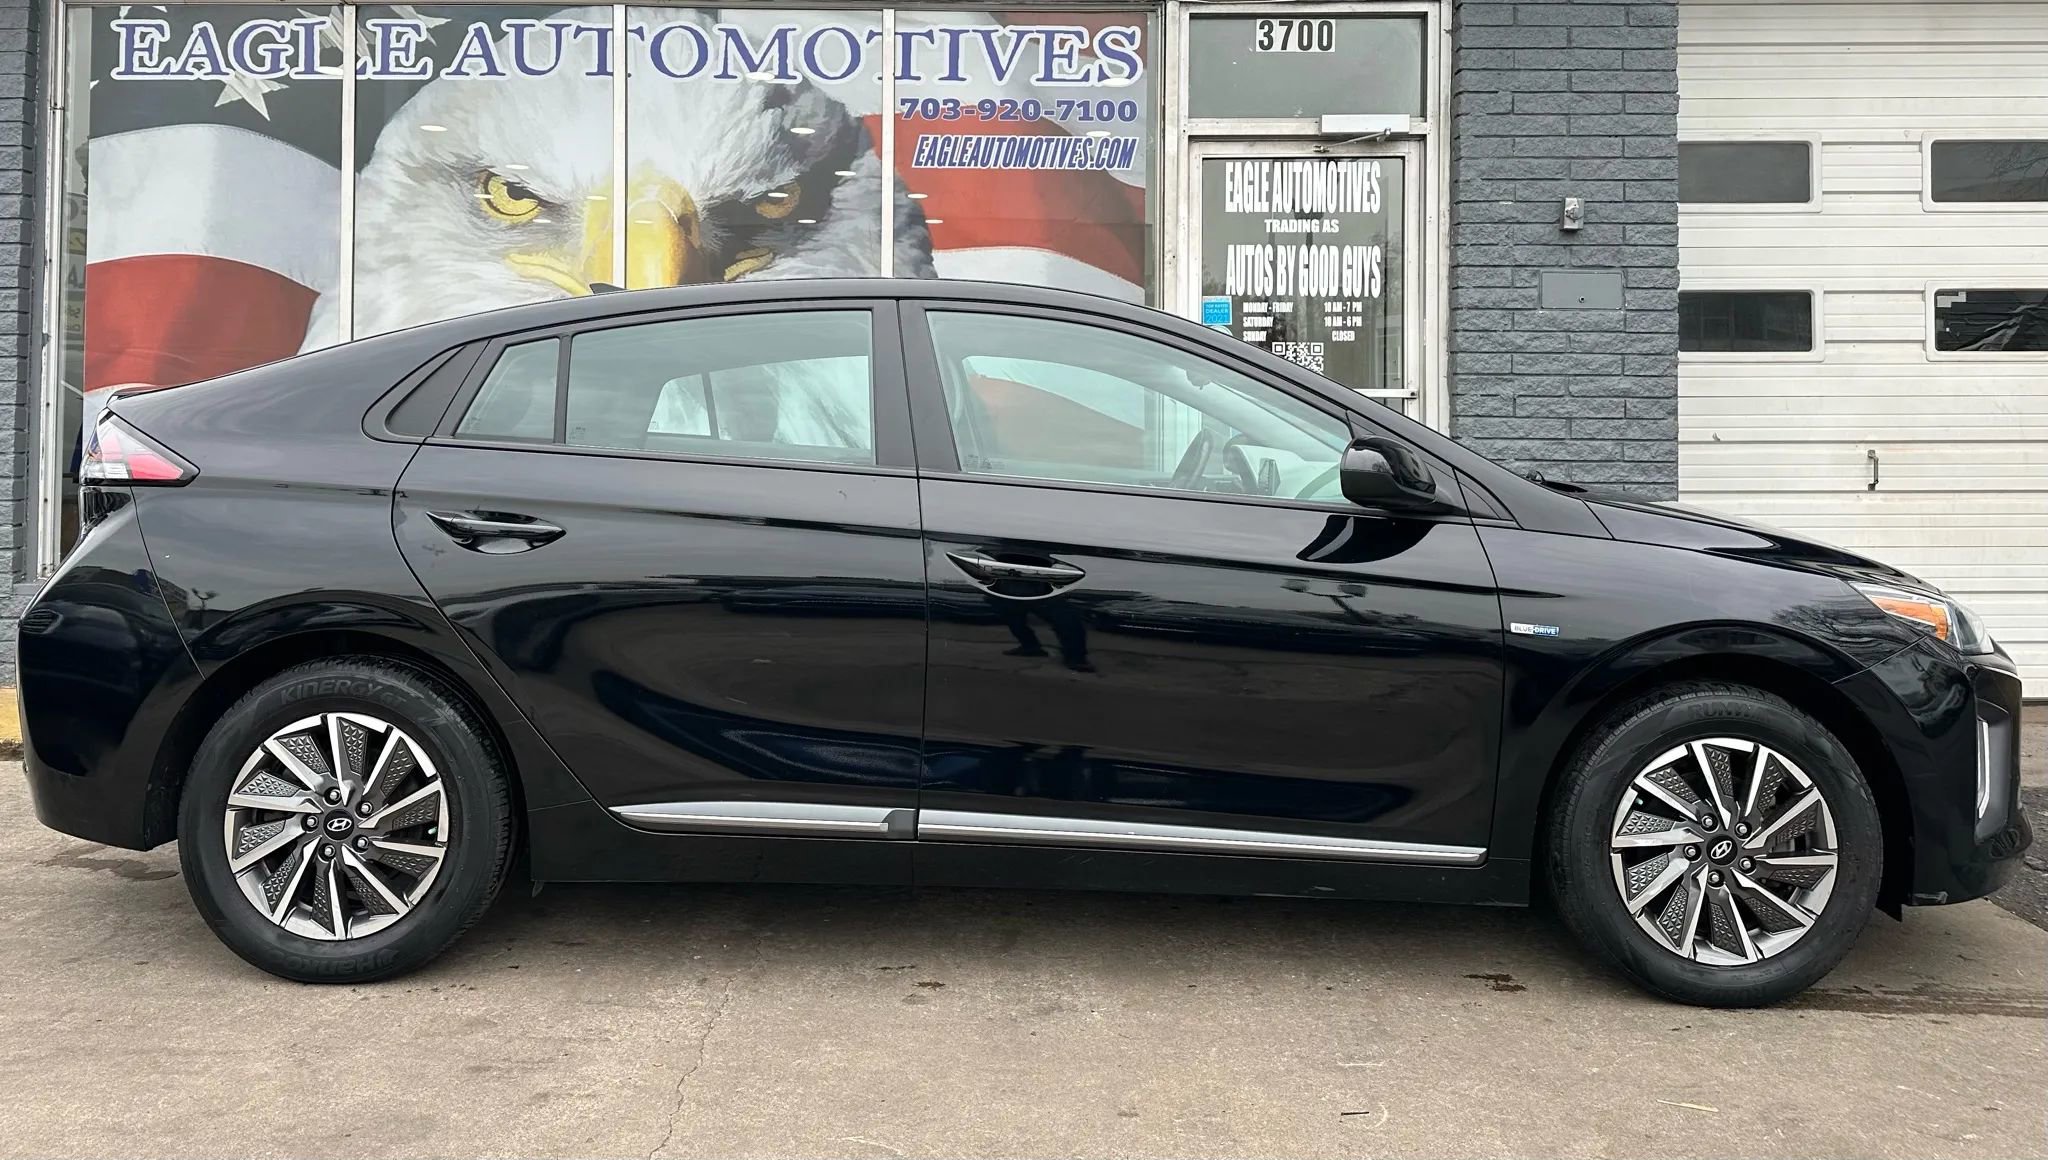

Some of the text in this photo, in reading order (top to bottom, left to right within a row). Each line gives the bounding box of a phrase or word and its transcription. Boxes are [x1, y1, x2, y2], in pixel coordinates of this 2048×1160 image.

[1258, 19, 1333, 51] 3700
[112, 20, 1142, 85] EAGLE AUTOMOTIVES
[900, 98, 1138, 122] 703-920-7100
[913, 135, 1139, 170] EAGLEAUTOMOTIVES.COM
[1225, 161, 1381, 214] EAGLE AUTOMOTIVES
[1264, 219, 1340, 233] TRADING AS
[1225, 244, 1382, 298] AUTOS BY GOOD GUYS
[1242, 301, 1269, 313] MONDAY
[1272, 301, 1294, 313] FRIDAY
[1324, 301, 1332, 313] 10
[1332, 301, 1343, 313] AM
[1352, 301, 1363, 313] PM
[1242, 316, 1274, 328] SATURDAY
[1324, 316, 1332, 327] 10
[1332, 316, 1343, 327] AM
[1352, 316, 1363, 327] PM
[1242, 330, 1356, 342] SUNDAY CLOSED
[280, 679, 383, 705] KINERGY
